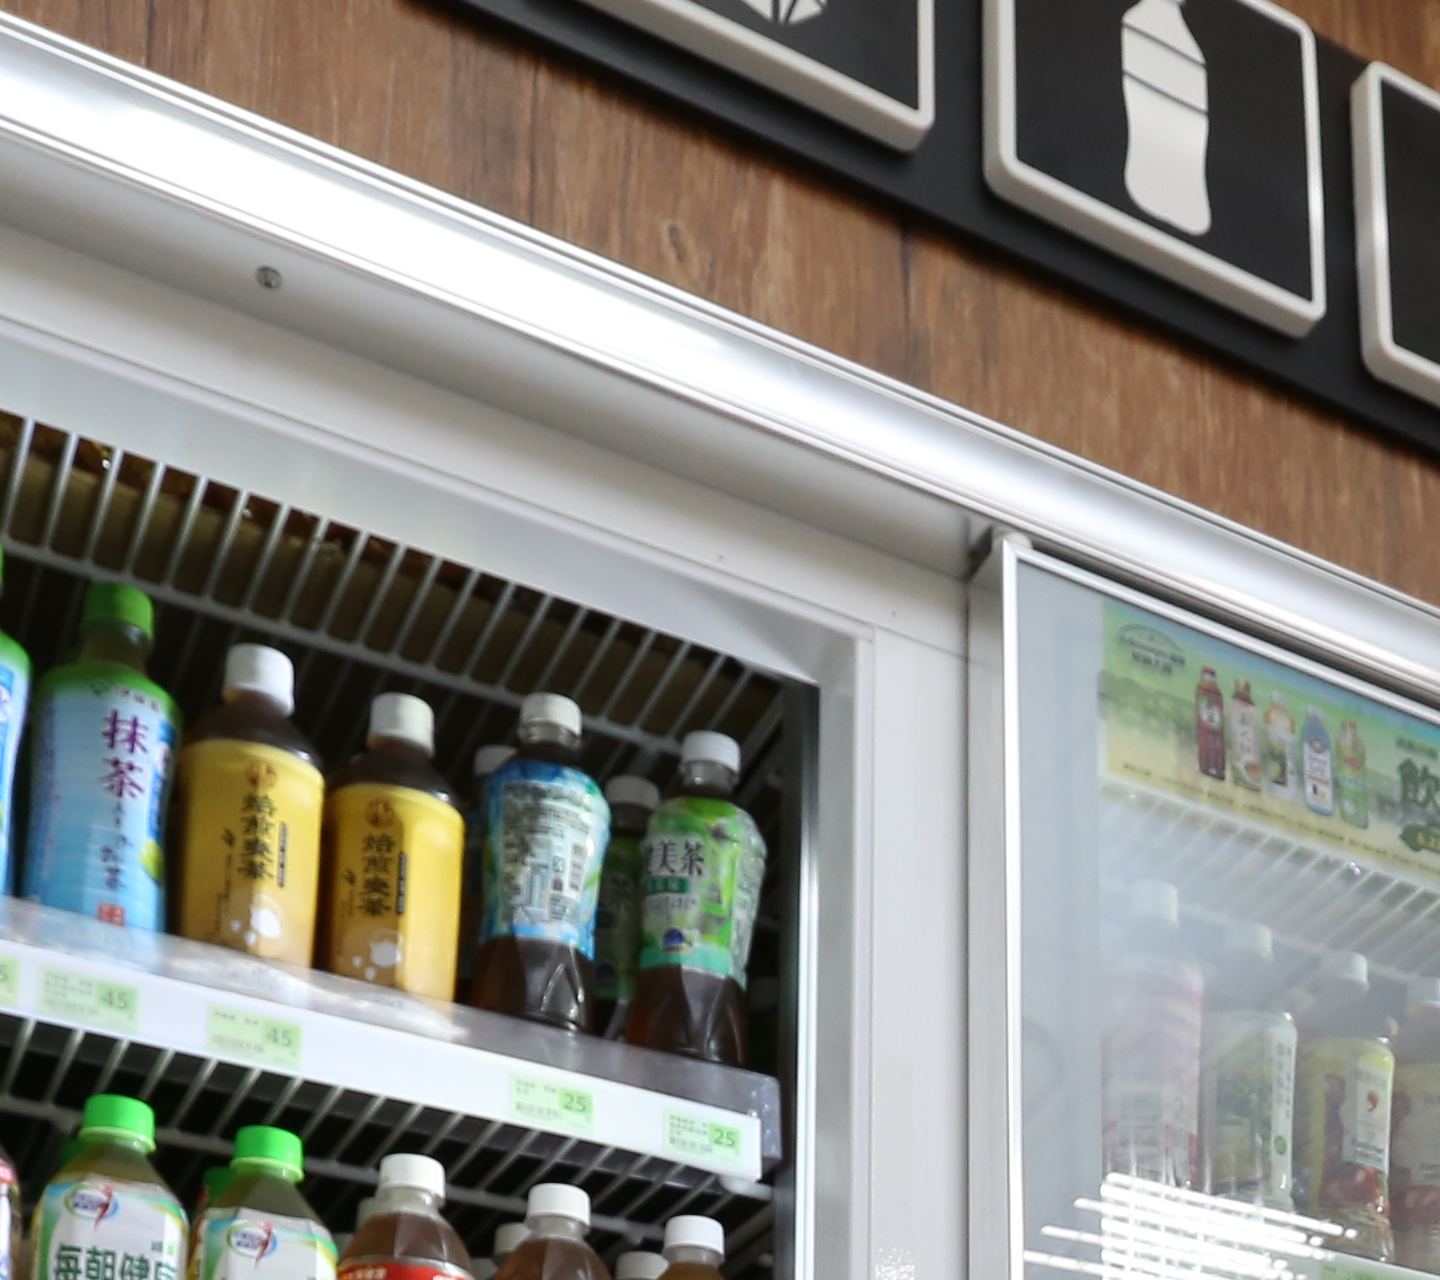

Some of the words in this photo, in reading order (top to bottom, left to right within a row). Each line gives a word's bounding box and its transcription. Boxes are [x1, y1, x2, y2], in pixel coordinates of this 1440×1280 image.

[100, 990, 129, 1011] 45
[265, 1024, 293, 1046] 45
[563, 1091, 588, 1113] 25
[713, 1127, 737, 1148] 25
